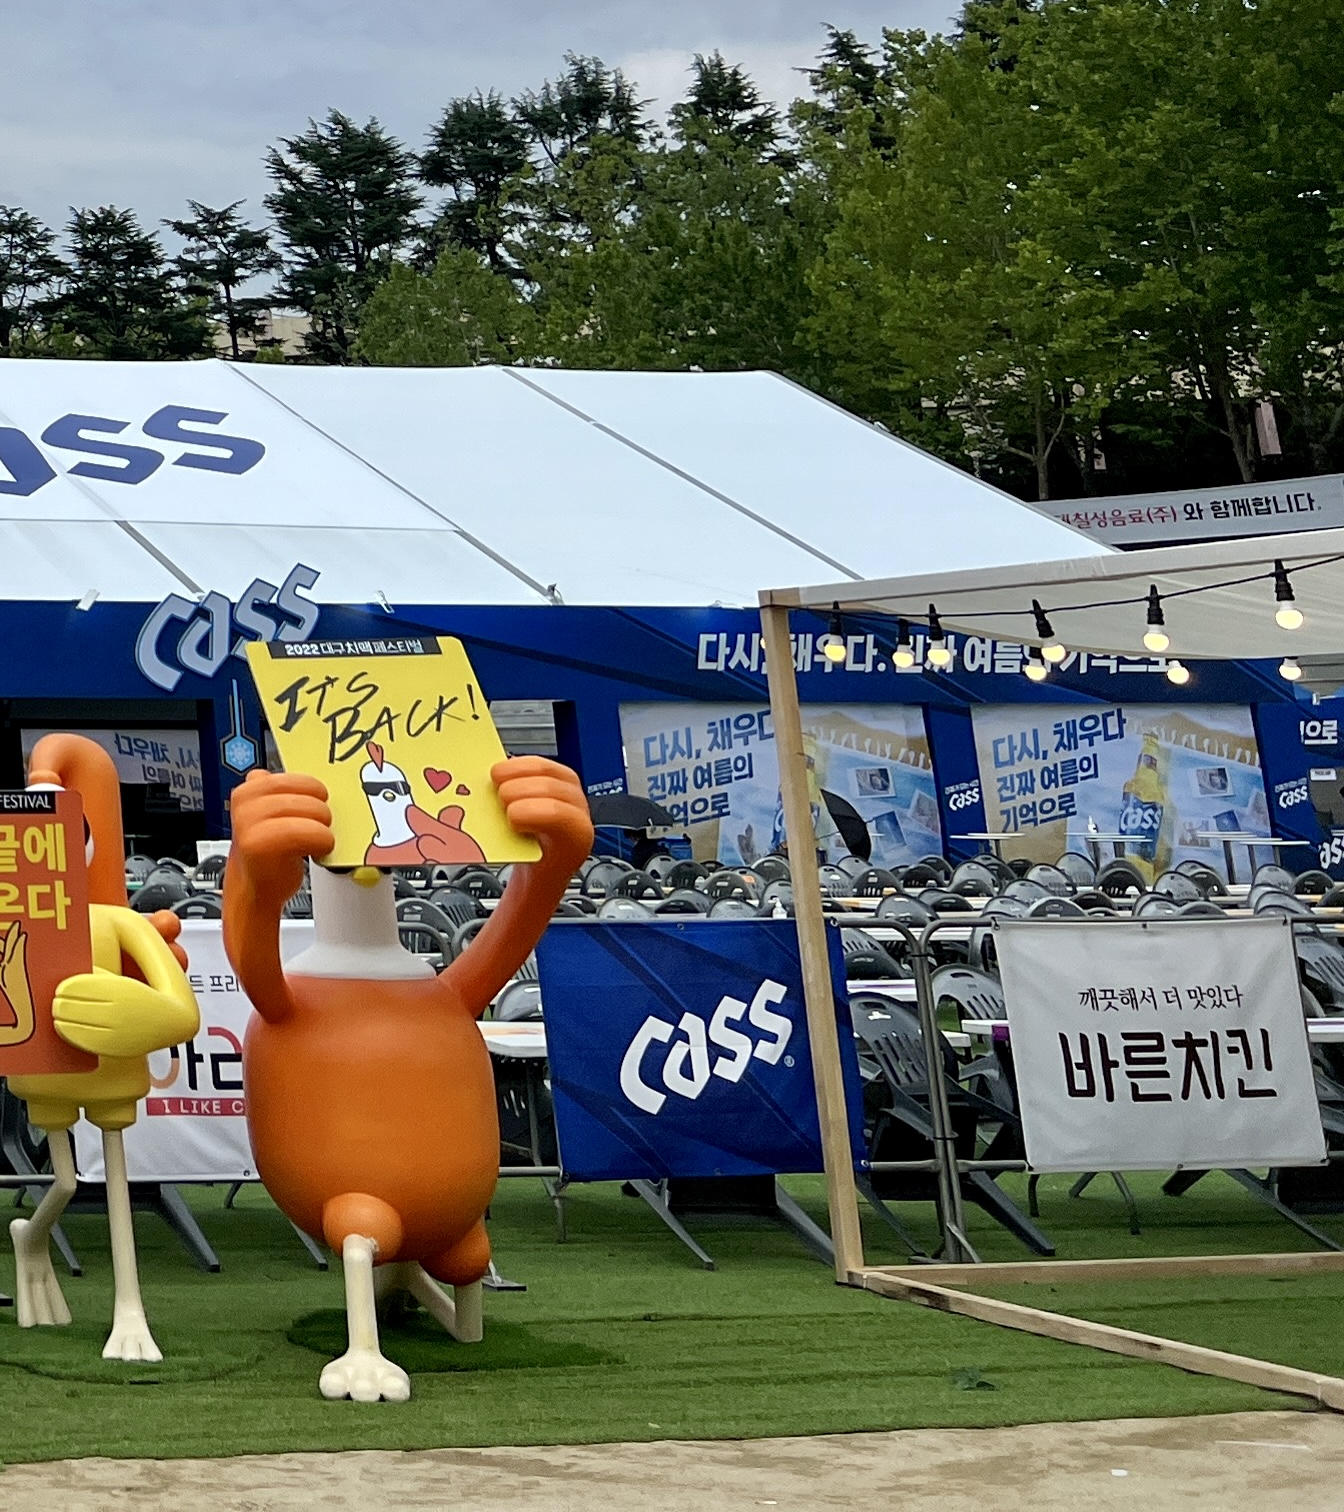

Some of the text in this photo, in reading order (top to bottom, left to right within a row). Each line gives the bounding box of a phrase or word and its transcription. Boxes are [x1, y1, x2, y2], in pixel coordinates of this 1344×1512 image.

[1055, 491, 1323, 529] 칠성음료(주) 와 함께합니다.
[285, 642, 320, 656] 2022
[322, 684, 480, 763] BACK!
[992, 707, 1127, 769] 다시, 채우다
[643, 727, 701, 768] 다시,
[647, 768, 688, 801] 진짜
[693, 753, 754, 789] 여름의
[996, 769, 1036, 803] 진짜
[1040, 753, 1099, 790] 여름의
[665, 791, 731, 827] 억으로
[1000, 791, 1077, 833] 기억으로
[1078, 984, 1244, 1012] 깨끗해서 더 맛있다
[1058, 1028, 1278, 1103] 바른치킨
[179, 1099, 222, 1114] LIKE
